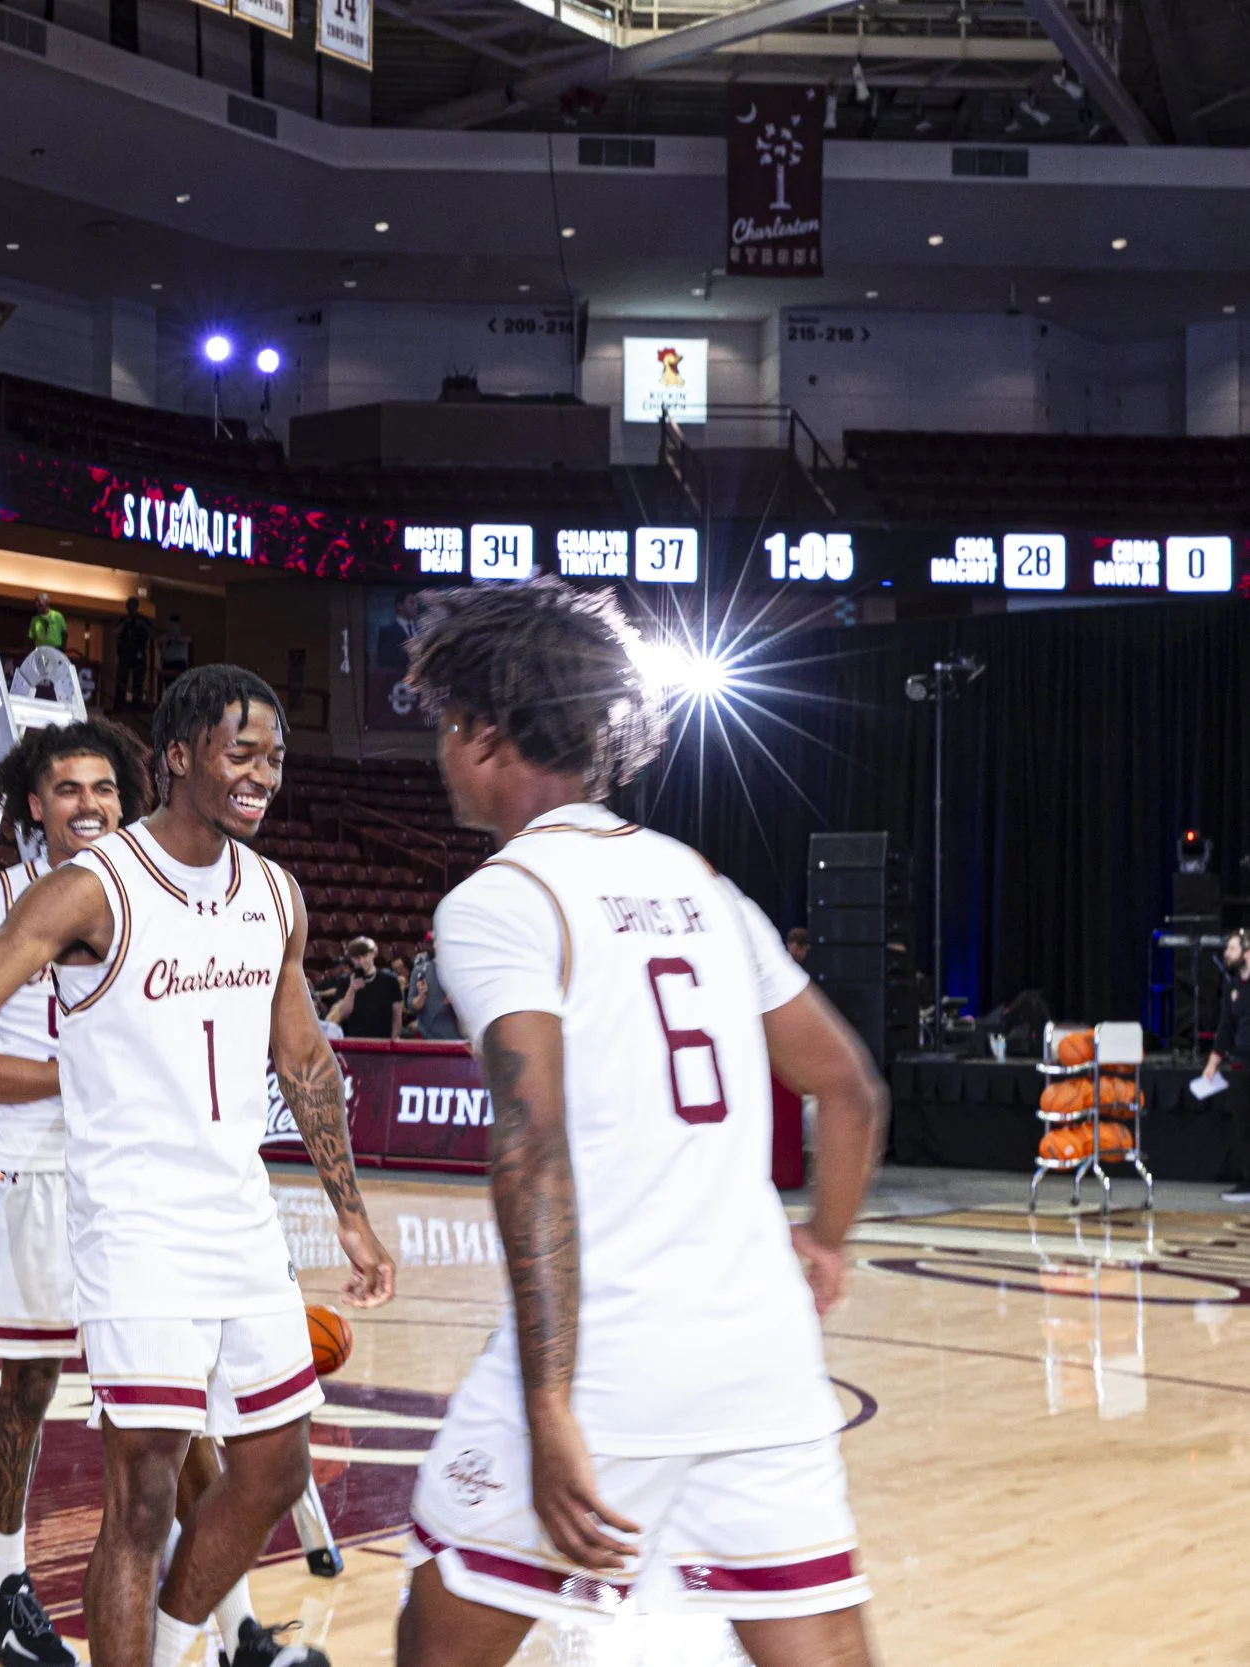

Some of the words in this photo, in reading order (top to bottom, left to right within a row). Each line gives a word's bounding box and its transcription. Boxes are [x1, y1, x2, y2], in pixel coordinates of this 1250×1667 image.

[732, 215, 819, 245] Charleston
[404, 526, 463, 550] MISTER
[483, 535, 518, 567] 34
[420, 549, 463, 573] DEAN
[559, 552, 628, 576] TRAYLOR
[650, 538, 684, 570] 37
[764, 532, 854, 581] 1:05
[1017, 545, 1051, 576] 28
[1188, 548, 1205, 579] 0
[242, 911, 266, 922] CAA
[144, 956, 271, 1000] Charleston
[646, 957, 729, 1125] 6
[203, 1019, 221, 1122] 1
